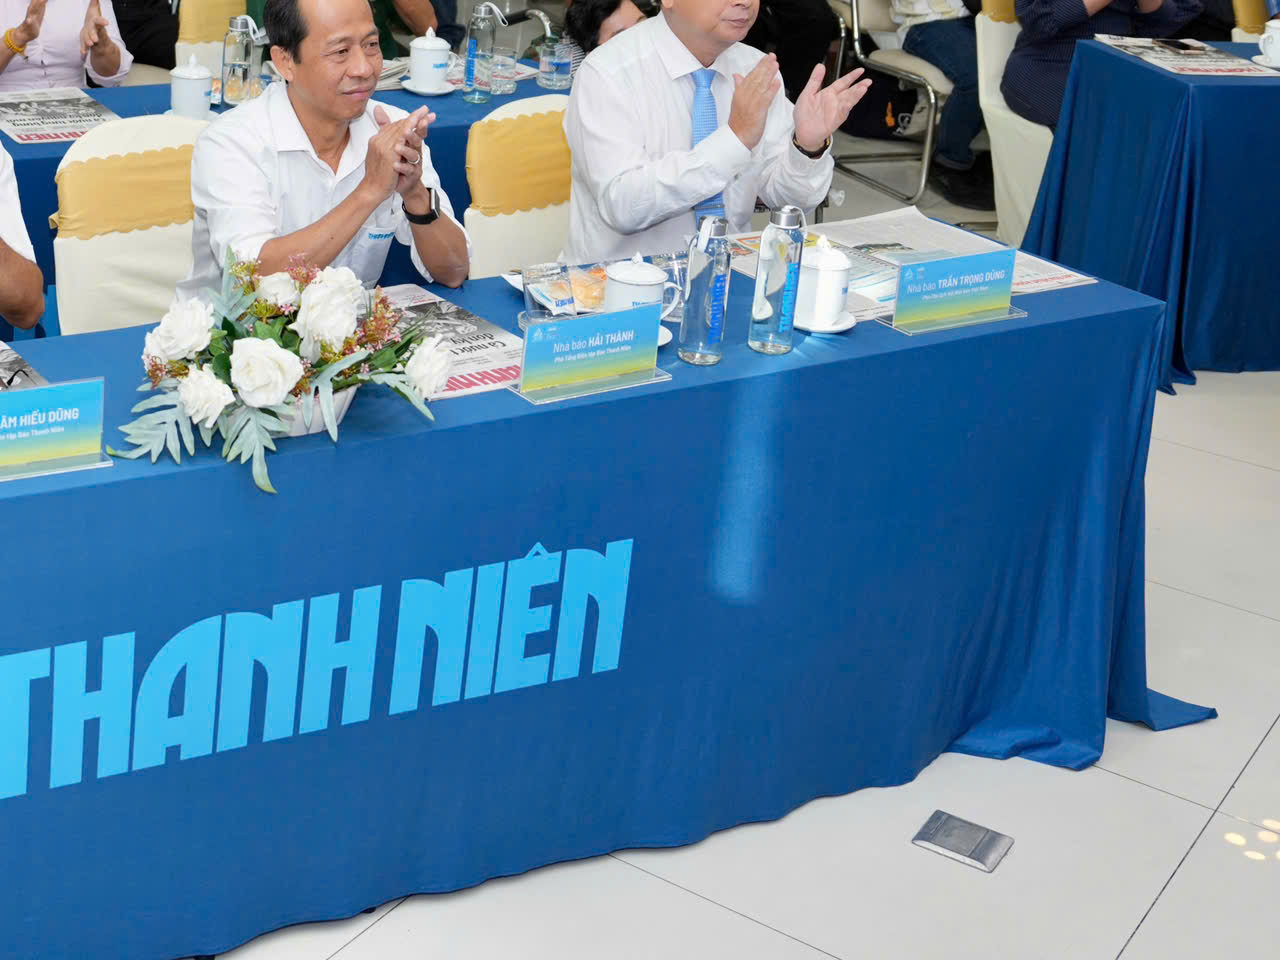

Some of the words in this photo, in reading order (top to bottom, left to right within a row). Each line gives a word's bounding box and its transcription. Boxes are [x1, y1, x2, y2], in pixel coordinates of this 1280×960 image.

[907, 283, 922, 294] Nhà
[959, 273, 984, 286] TRỌNG
[985, 269, 1005, 281] DŨNG
[553, 342, 570, 353] Nhà
[571, 338, 587, 351] báo
[588, 332, 604, 347] HẢI
[605, 329, 634, 345] THÀNH
[20, 409, 47, 427] HIẾU
[48, 407, 80, 423] DŨNG
[388, 538, 634, 717] NIÊN
